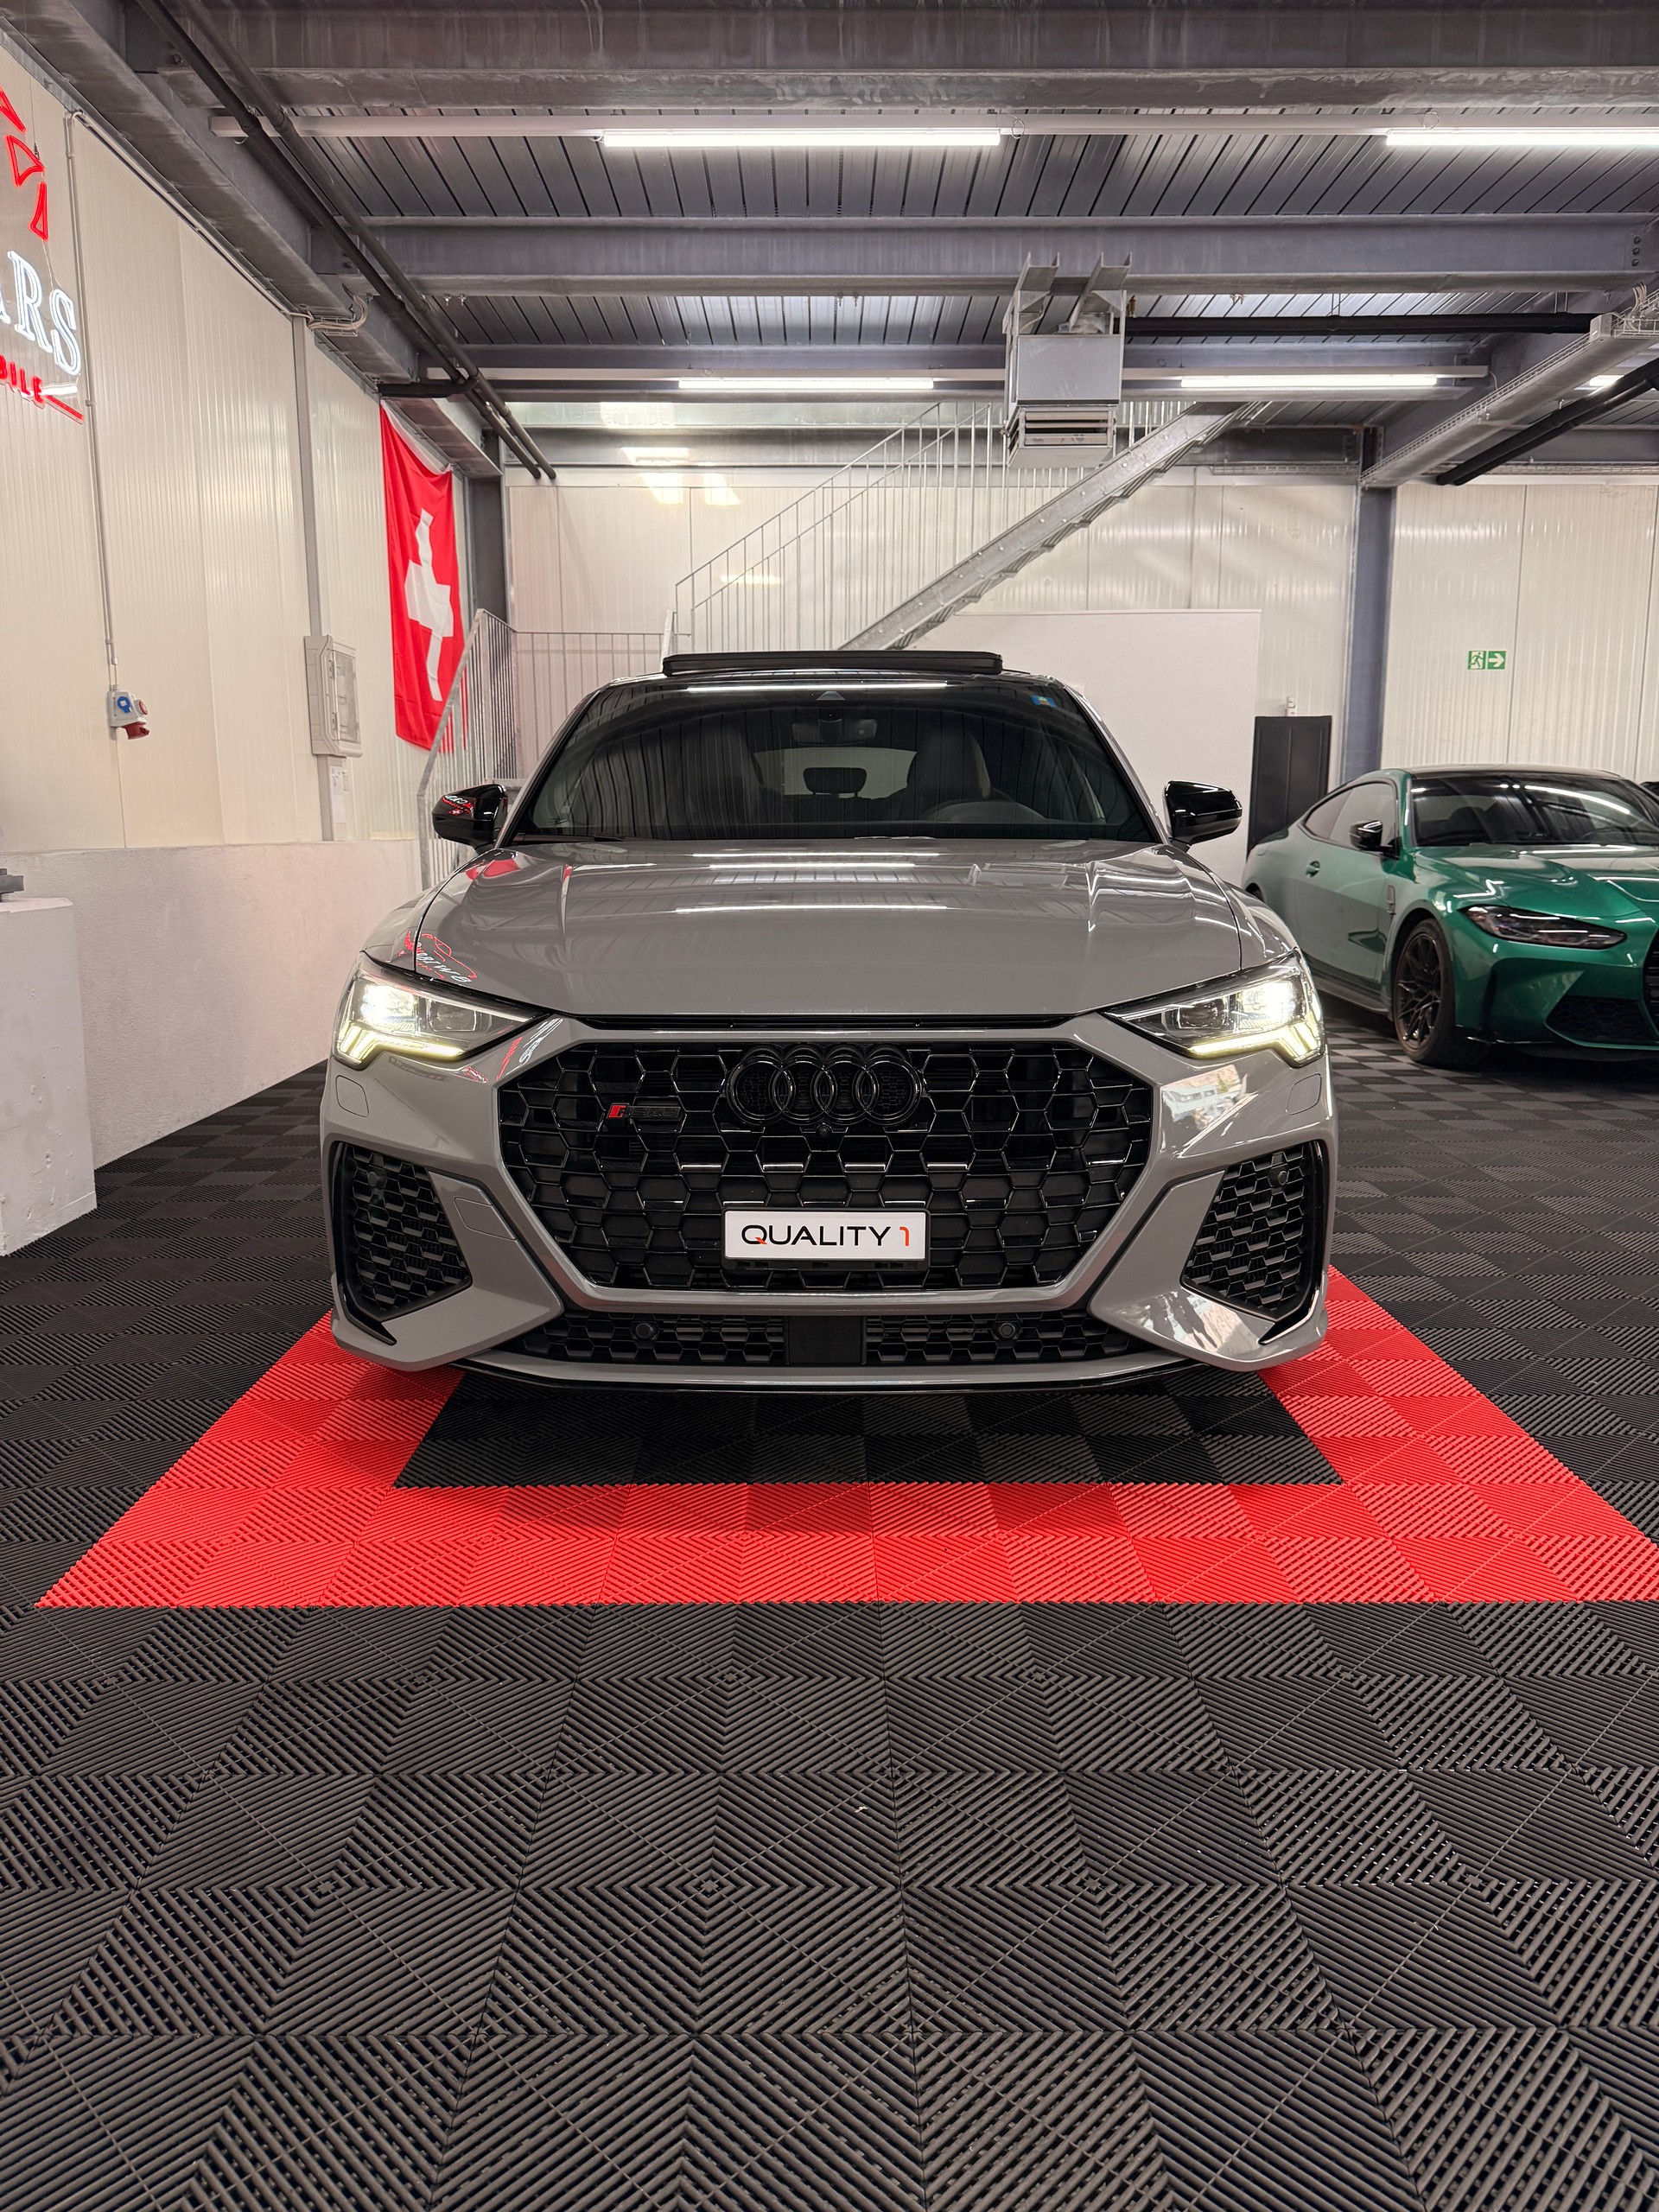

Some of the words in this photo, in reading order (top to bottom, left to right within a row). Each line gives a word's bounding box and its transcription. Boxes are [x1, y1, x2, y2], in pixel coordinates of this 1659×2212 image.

[0, 250, 81, 376] RS
[741, 1224, 892, 1246] QUALITY
[899, 1226, 910, 1247] 1
